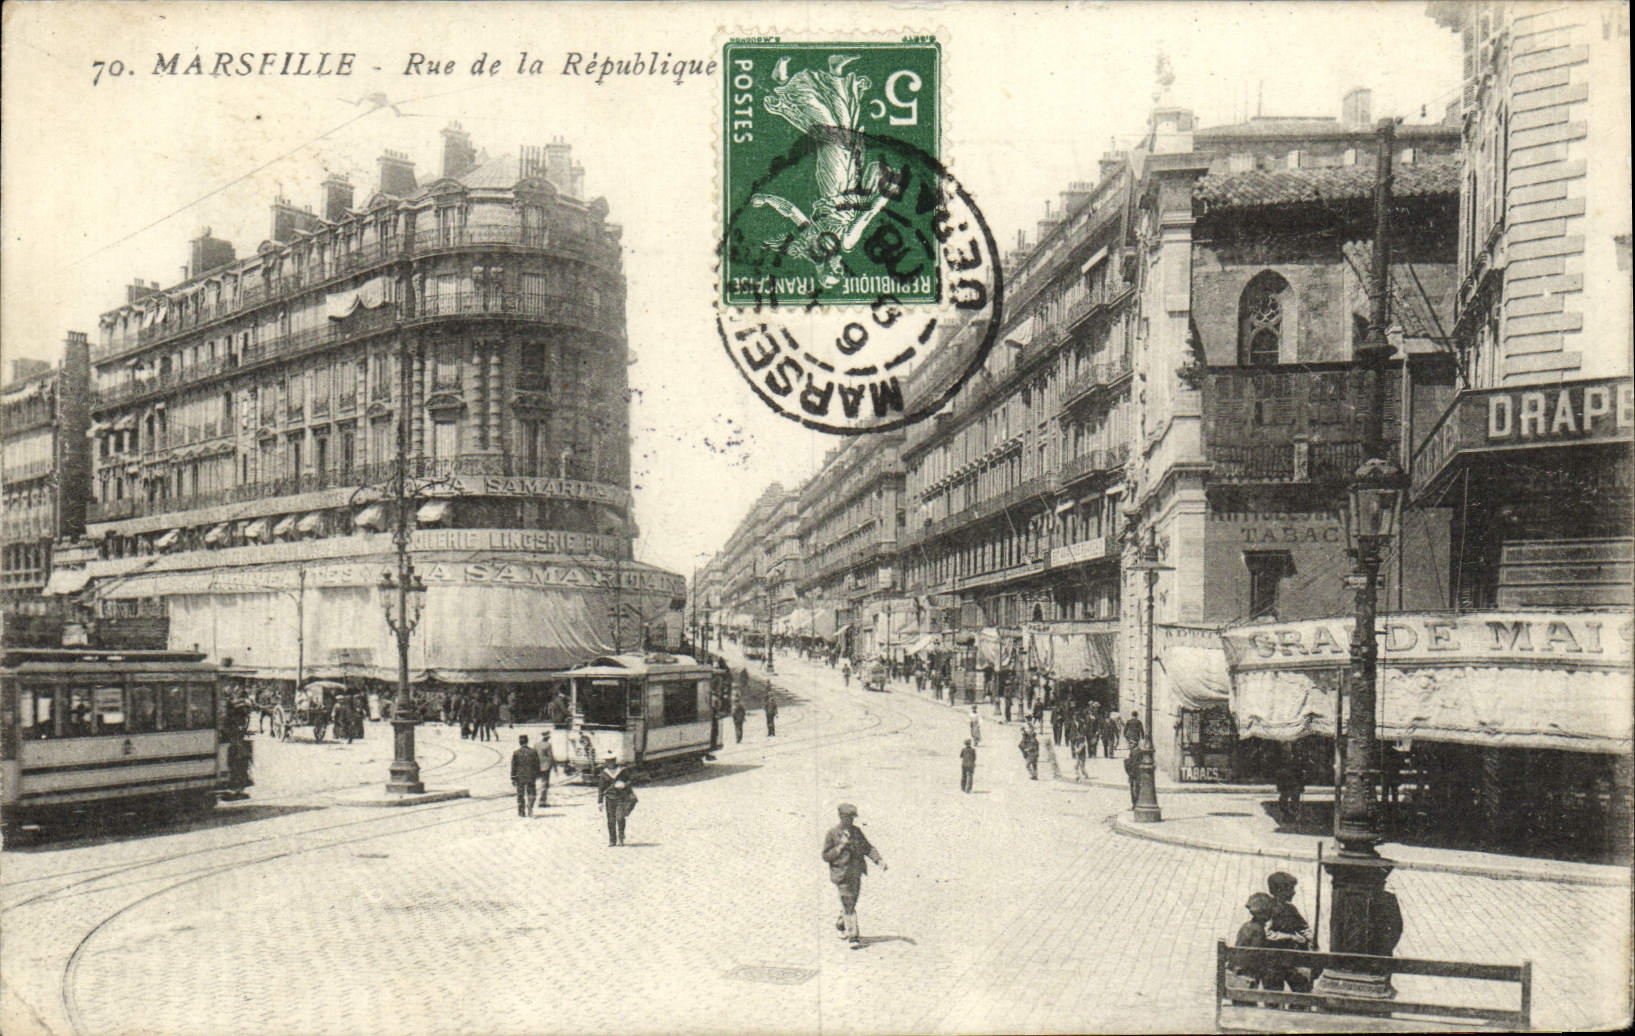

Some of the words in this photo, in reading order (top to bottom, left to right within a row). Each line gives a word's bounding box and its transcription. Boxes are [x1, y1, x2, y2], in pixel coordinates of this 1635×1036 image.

[733, 58, 754, 144] POSTES
[884, 70, 924, 127] 5
[1240, 527, 1339, 543] TABAC
[1248, 620, 1461, 659] GRADE
